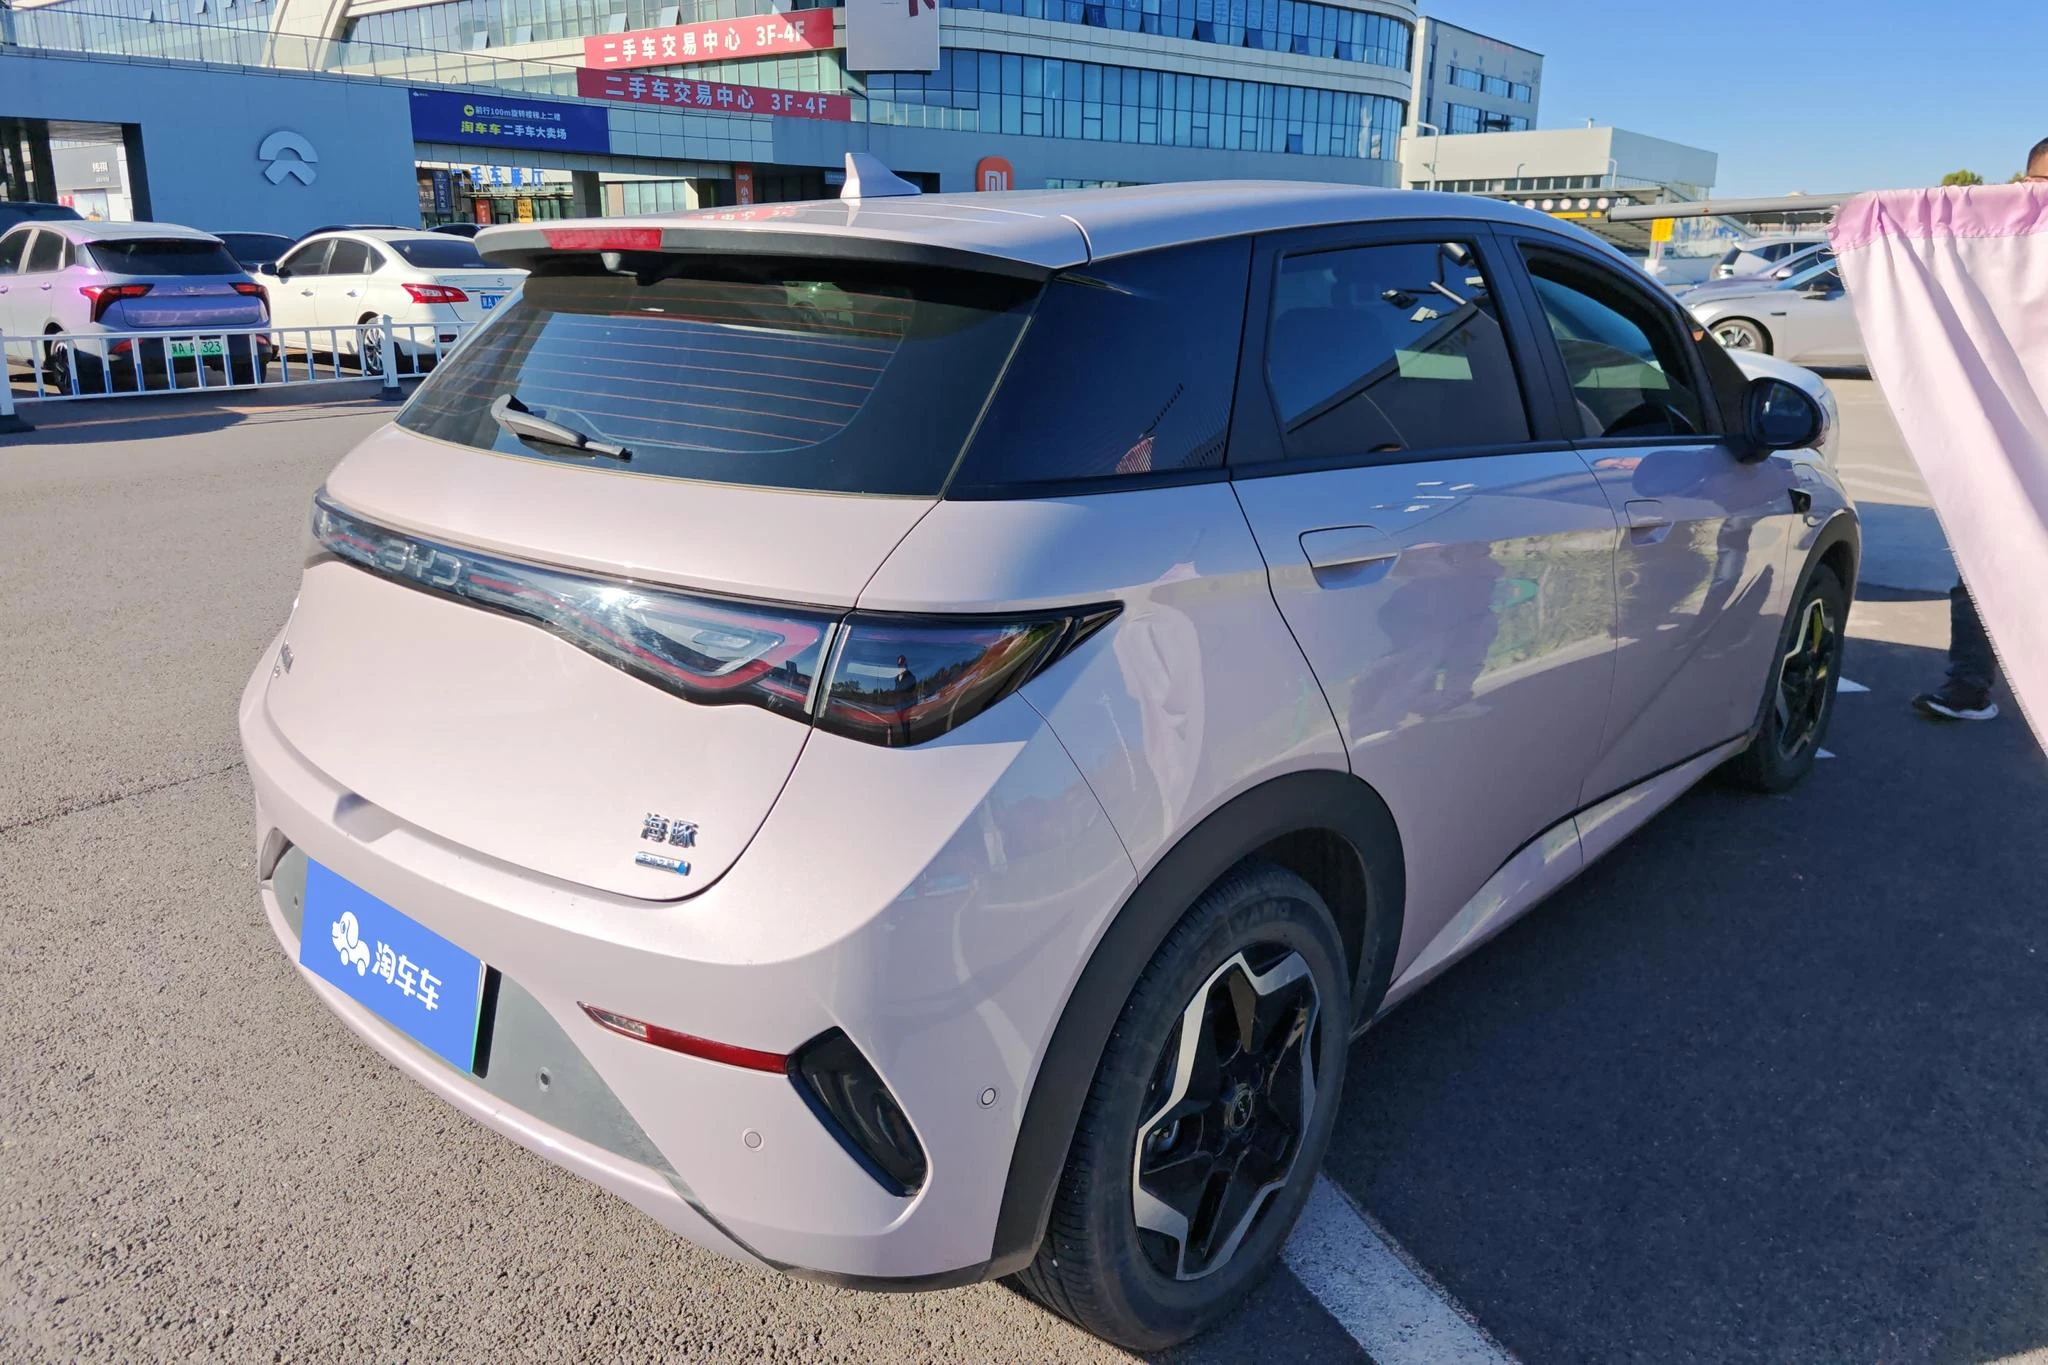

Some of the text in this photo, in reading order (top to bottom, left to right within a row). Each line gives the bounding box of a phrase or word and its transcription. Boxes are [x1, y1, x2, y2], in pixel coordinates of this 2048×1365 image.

[603, 20, 805, 63] 二手车交易中心 3F-4F
[605, 75, 755, 109] 二手车交易中心
[461, 120, 567, 140] 淘车车 二手车大卖场
[384, 539, 461, 587] BYD
[640, 812, 699, 848] 海豚
